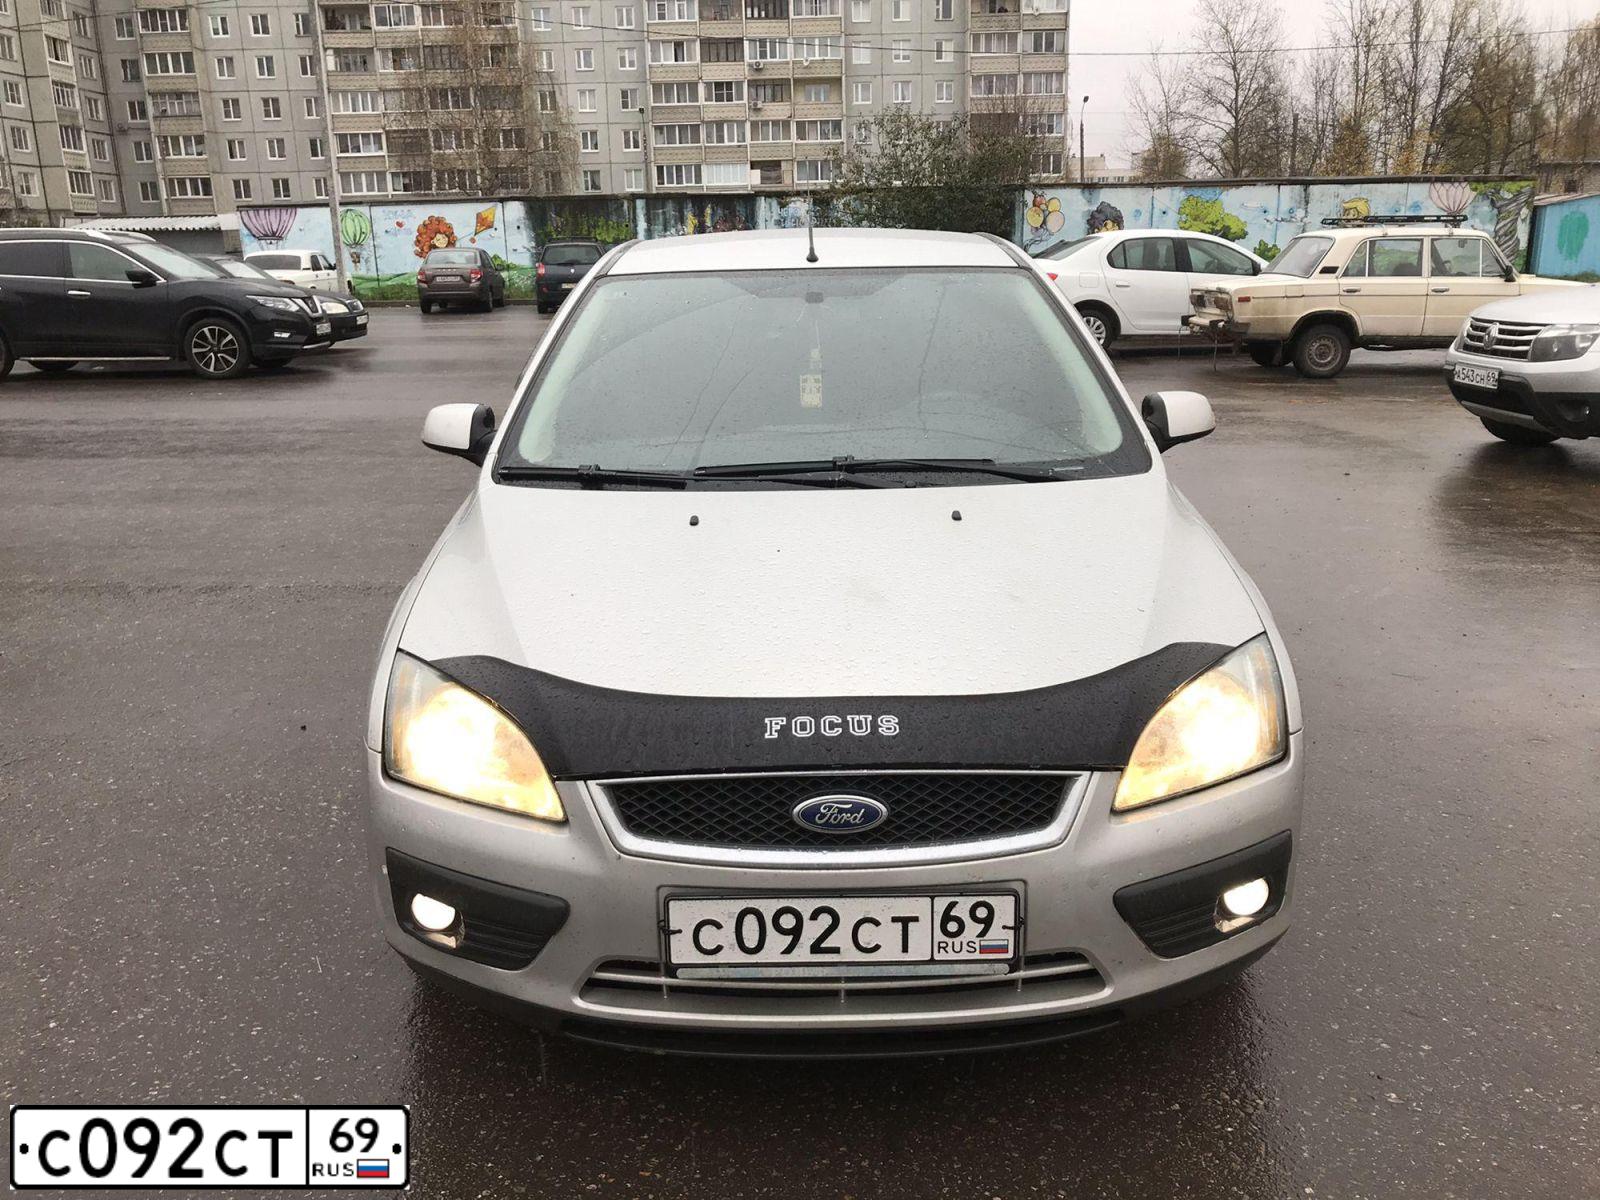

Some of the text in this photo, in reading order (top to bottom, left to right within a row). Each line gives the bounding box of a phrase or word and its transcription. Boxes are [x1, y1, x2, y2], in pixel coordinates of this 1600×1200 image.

[764, 714, 900, 739] FOCUS
[814, 802, 865, 825] Ford
[692, 905, 919, 956] C092CT
[939, 900, 995, 939] 69
[937, 940, 978, 954] RUS
